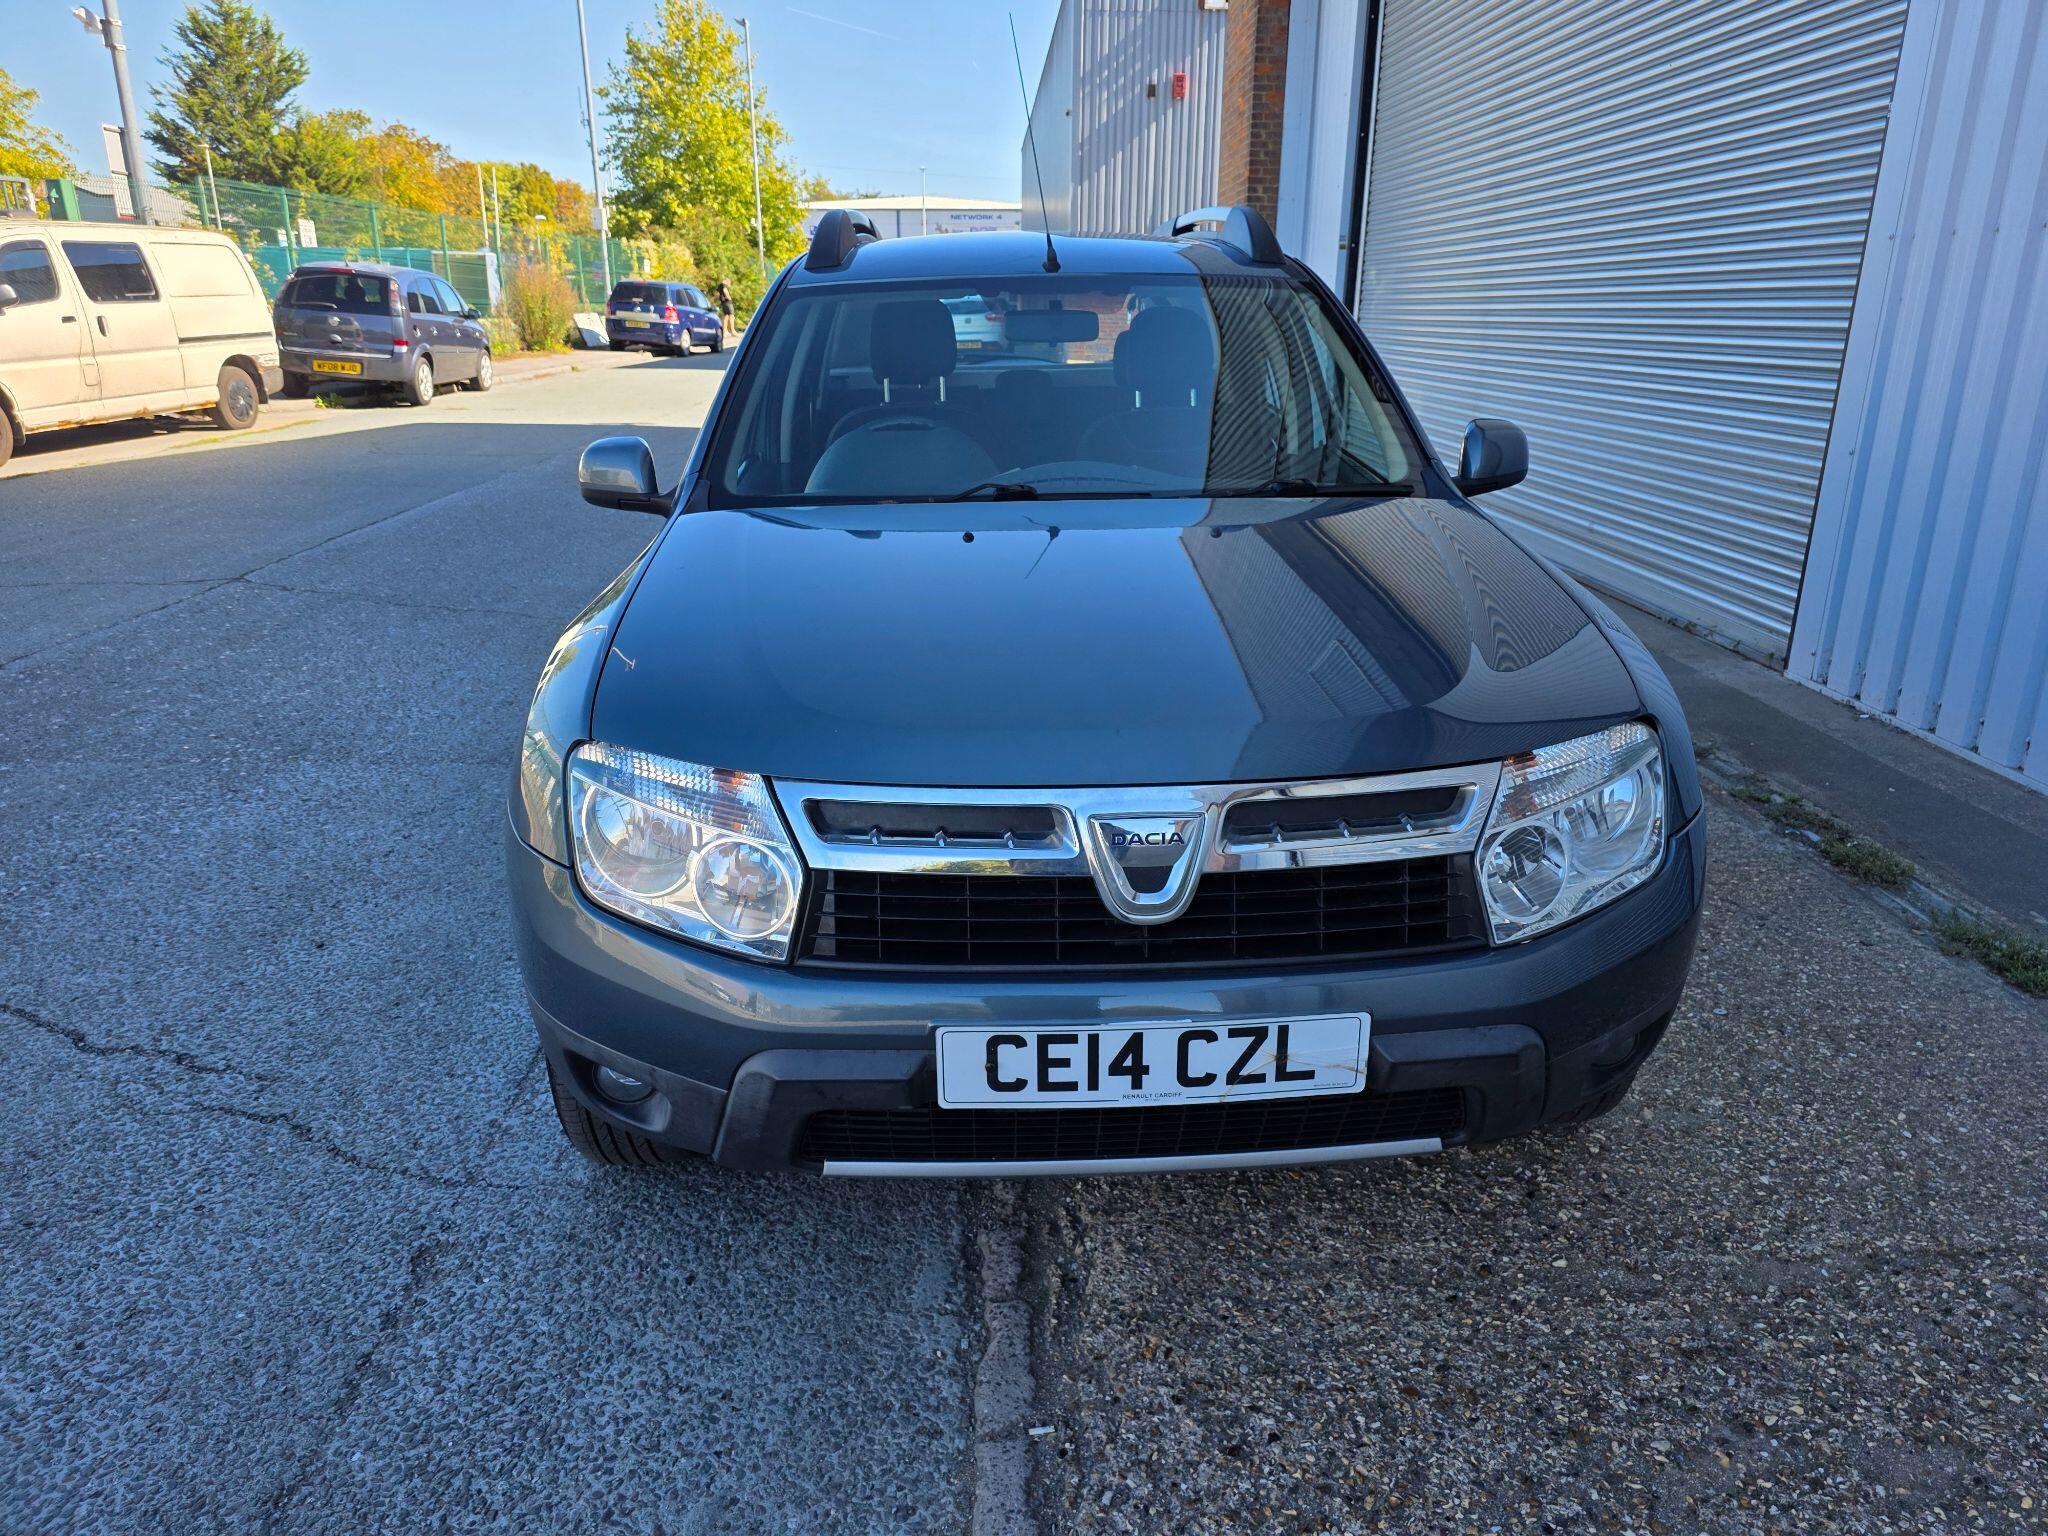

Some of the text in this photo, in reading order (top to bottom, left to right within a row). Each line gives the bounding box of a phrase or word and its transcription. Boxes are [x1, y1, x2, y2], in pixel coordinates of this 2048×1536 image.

[1111, 832, 1185, 846] DACIA
[985, 1024, 1316, 1093] CE14 CZL
